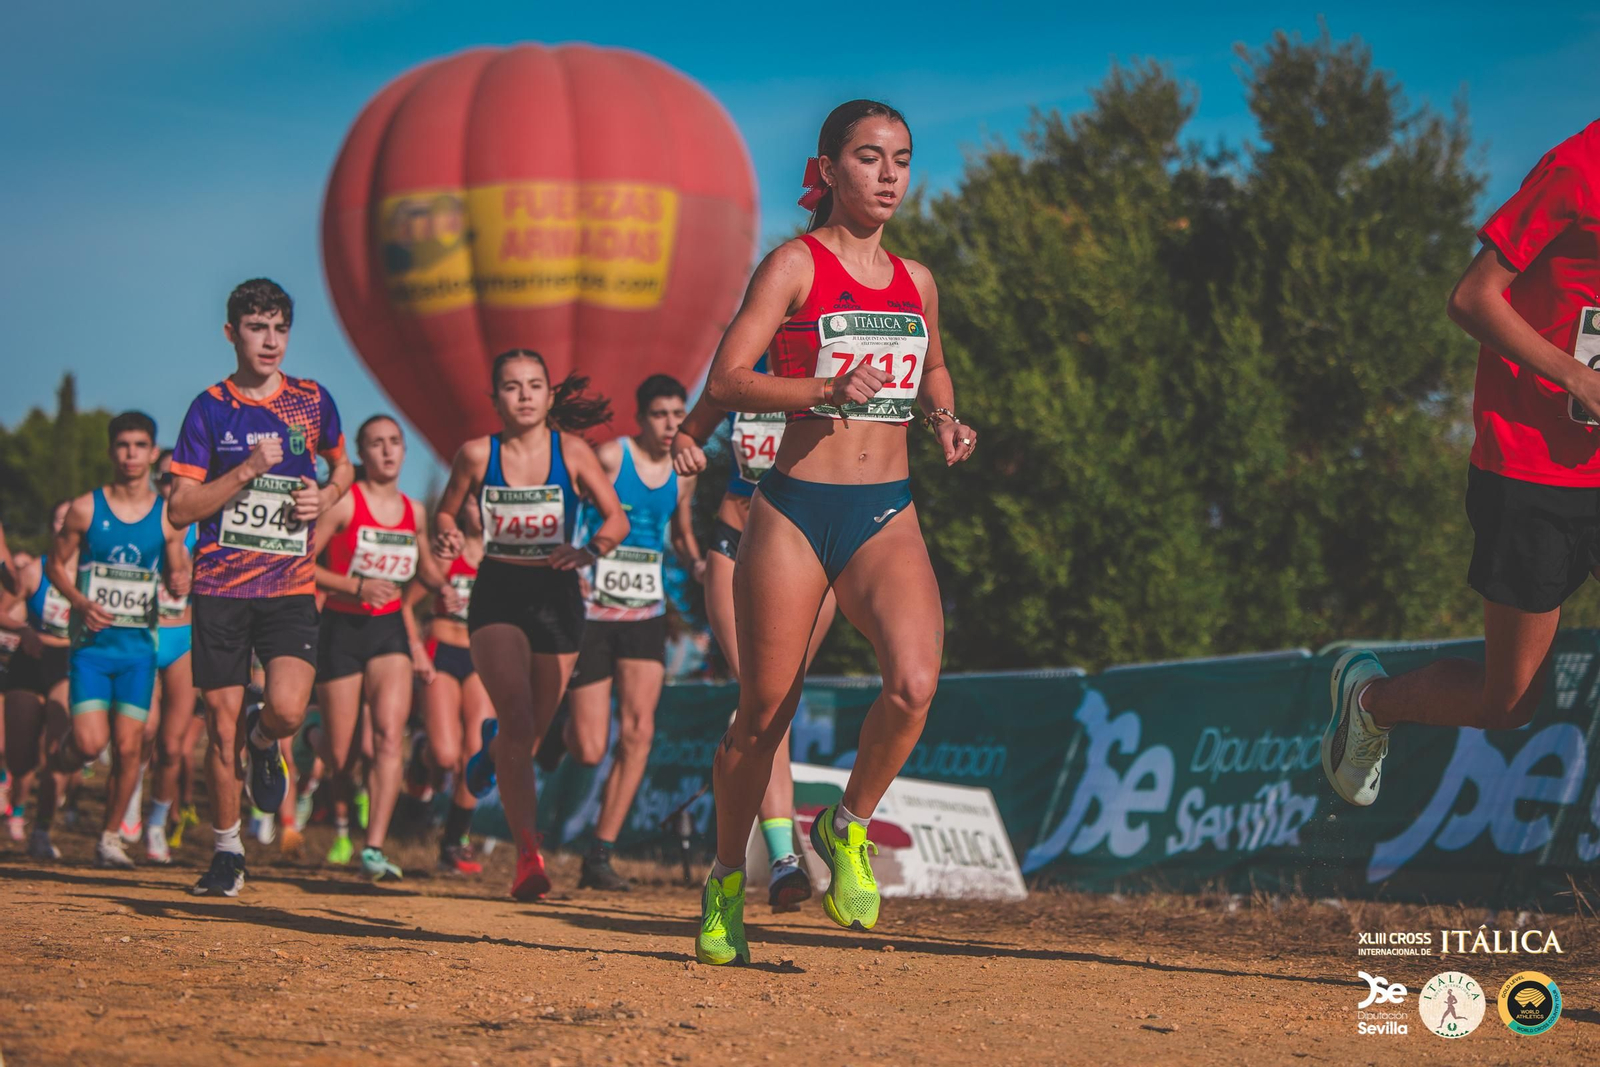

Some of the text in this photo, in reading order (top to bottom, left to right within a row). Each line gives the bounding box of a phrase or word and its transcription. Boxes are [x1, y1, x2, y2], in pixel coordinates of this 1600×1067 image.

[854, 315, 901, 329] ITÁLICA
[741, 434, 776, 462] 54
[491, 513, 558, 539] 7459
[359, 552, 412, 576] 5473
[604, 570, 656, 593] 6043
[96, 587, 149, 611] 8064
[1190, 724, 1323, 783] Diputació
